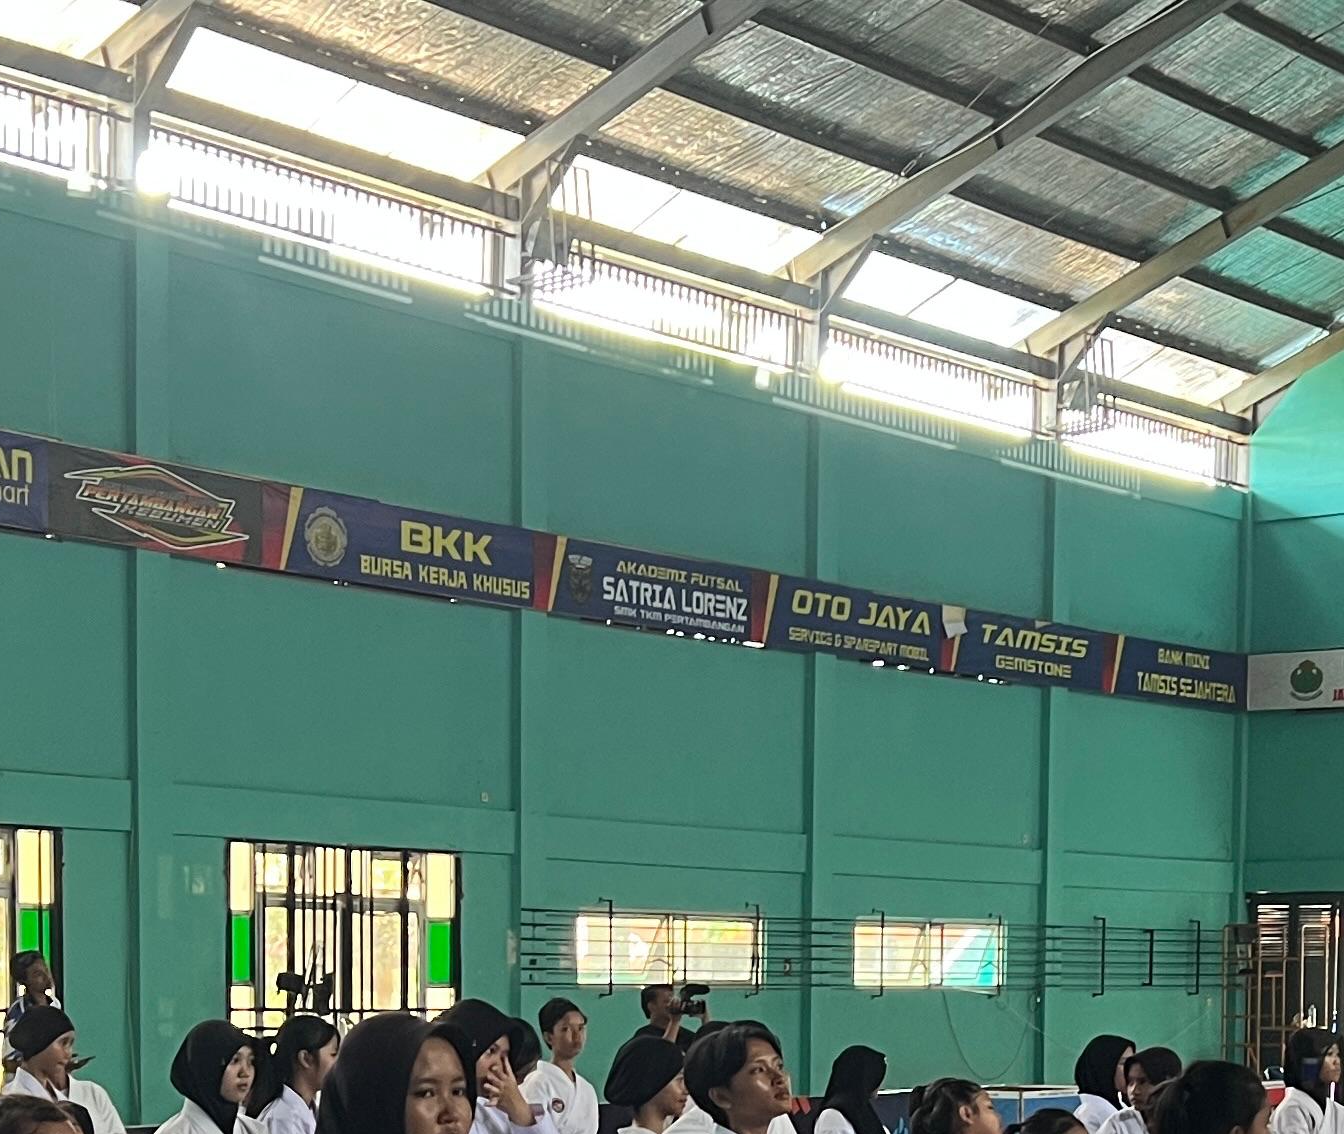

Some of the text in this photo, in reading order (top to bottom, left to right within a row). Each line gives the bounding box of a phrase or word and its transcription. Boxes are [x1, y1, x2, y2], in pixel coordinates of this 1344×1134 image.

[400, 520, 493, 566] BKK
[360, 554, 530, 599] BURSA KERJA KHUSUS
[616, 560, 743, 593] AKADEMI FUTSAL
[603, 576, 748, 621] SATRIA LORENZ
[792, 589, 931, 636] OTO JAYA
[664, 613, 745, 634] PERTAMBANGAN
[834, 634, 842, 647] &
[843, 635, 898, 656] SPAREPART
[982, 624, 1089, 658] TAMSIS
[1158, 648, 1184, 666] BANK
[995, 654, 1072, 678] GEMSTONE
[1137, 671, 1236, 703] TAMSIS SEJAHTERA
